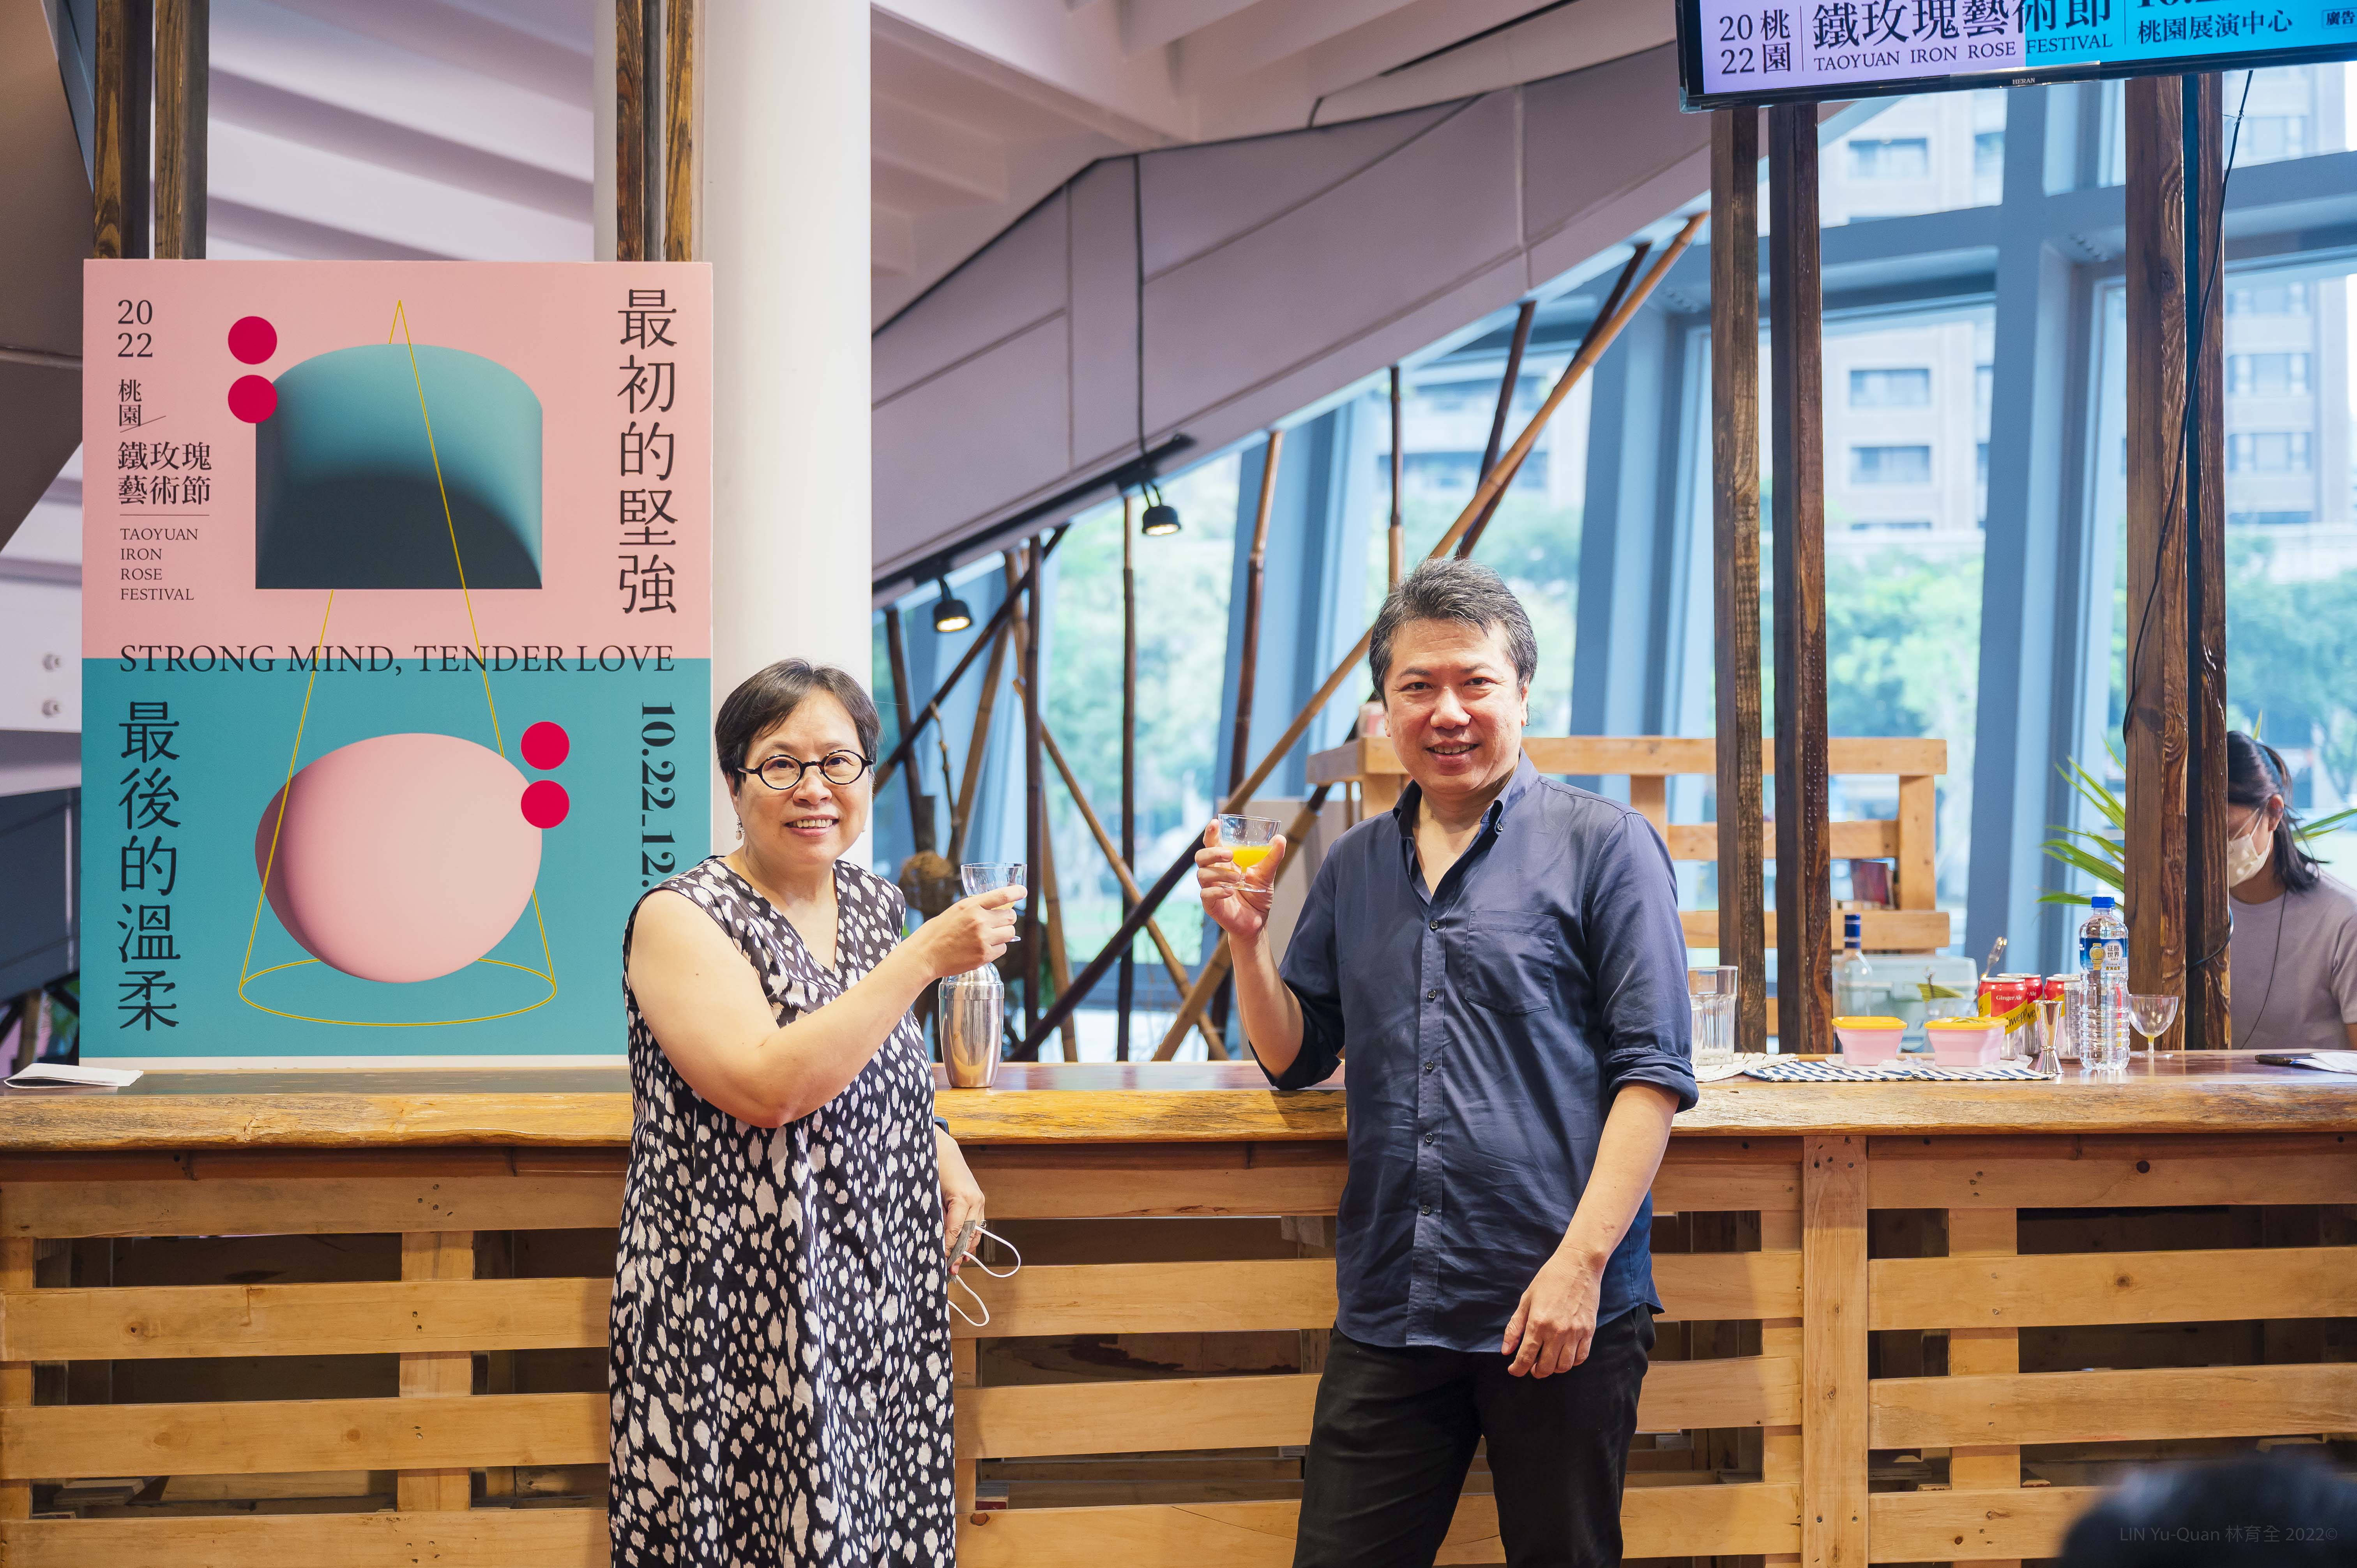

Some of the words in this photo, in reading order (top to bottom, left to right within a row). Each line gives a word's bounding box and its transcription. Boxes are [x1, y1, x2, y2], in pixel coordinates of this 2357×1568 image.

[1719, 14, 1753, 42] 20
[2137, 10, 2293, 45] 桃園展演中心
[1721, 48, 1755, 75] 22
[1814, 51, 1900, 71] TAOYUAN
[1910, 46, 1958, 64] IRON
[1968, 41, 2016, 59] ROSE
[2027, 34, 2113, 54] FESTIVAL
[118, 300, 153, 325] 20
[118, 333, 153, 358] 22
[118, 441, 212, 471] 鐵玫瑰
[617, 289, 678, 614] 最初的堅強
[118, 475, 211, 505] 藝術節
[120, 528, 199, 541] TAOYUAN
[120, 548, 162, 561] IRON
[120, 568, 163, 581] ROSE
[120, 588, 194, 601] FESTIVAL
[120, 645, 276, 673] STRONG
[286, 646, 402, 676] MIND,
[414, 645, 568, 672] TENDER
[576, 645, 675, 673] LOVE
[118, 701, 182, 1031] 最後的溫柔
